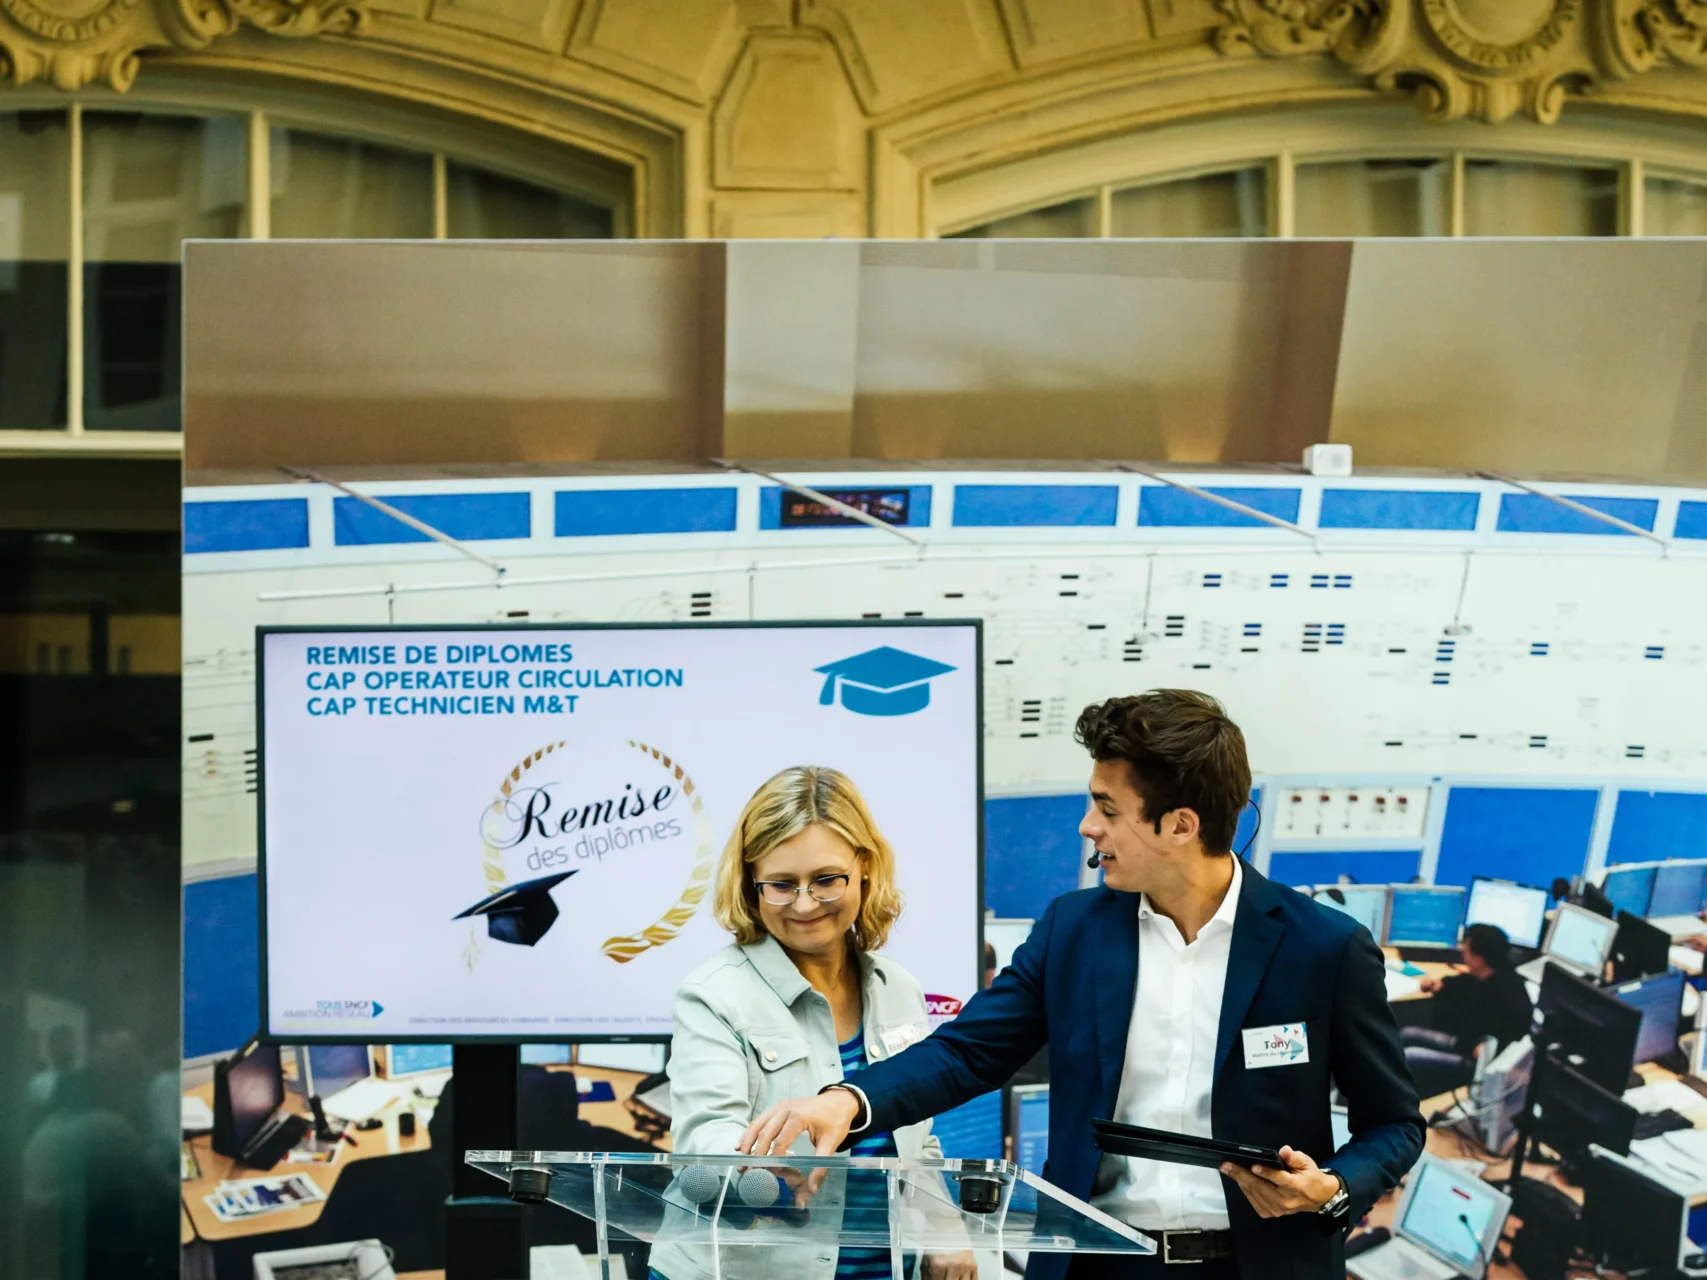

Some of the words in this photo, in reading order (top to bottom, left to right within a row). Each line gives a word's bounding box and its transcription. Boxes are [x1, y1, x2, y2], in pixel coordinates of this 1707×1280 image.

[307, 646, 396, 665] REMISE
[405, 645, 437, 664] DE
[446, 643, 573, 664] DIPLOMES
[306, 671, 356, 690] CAP
[364, 669, 510, 690] OPERATEUR
[518, 668, 683, 689] CIRCULATION
[306, 697, 356, 716] CAP
[364, 695, 514, 716] TECHNICIEN
[524, 694, 580, 714] M&T
[480, 782, 678, 849] Remise
[526, 845, 569, 872] des
[575, 817, 682, 863] diplômes
[1264, 1040, 1291, 1050] Tony
